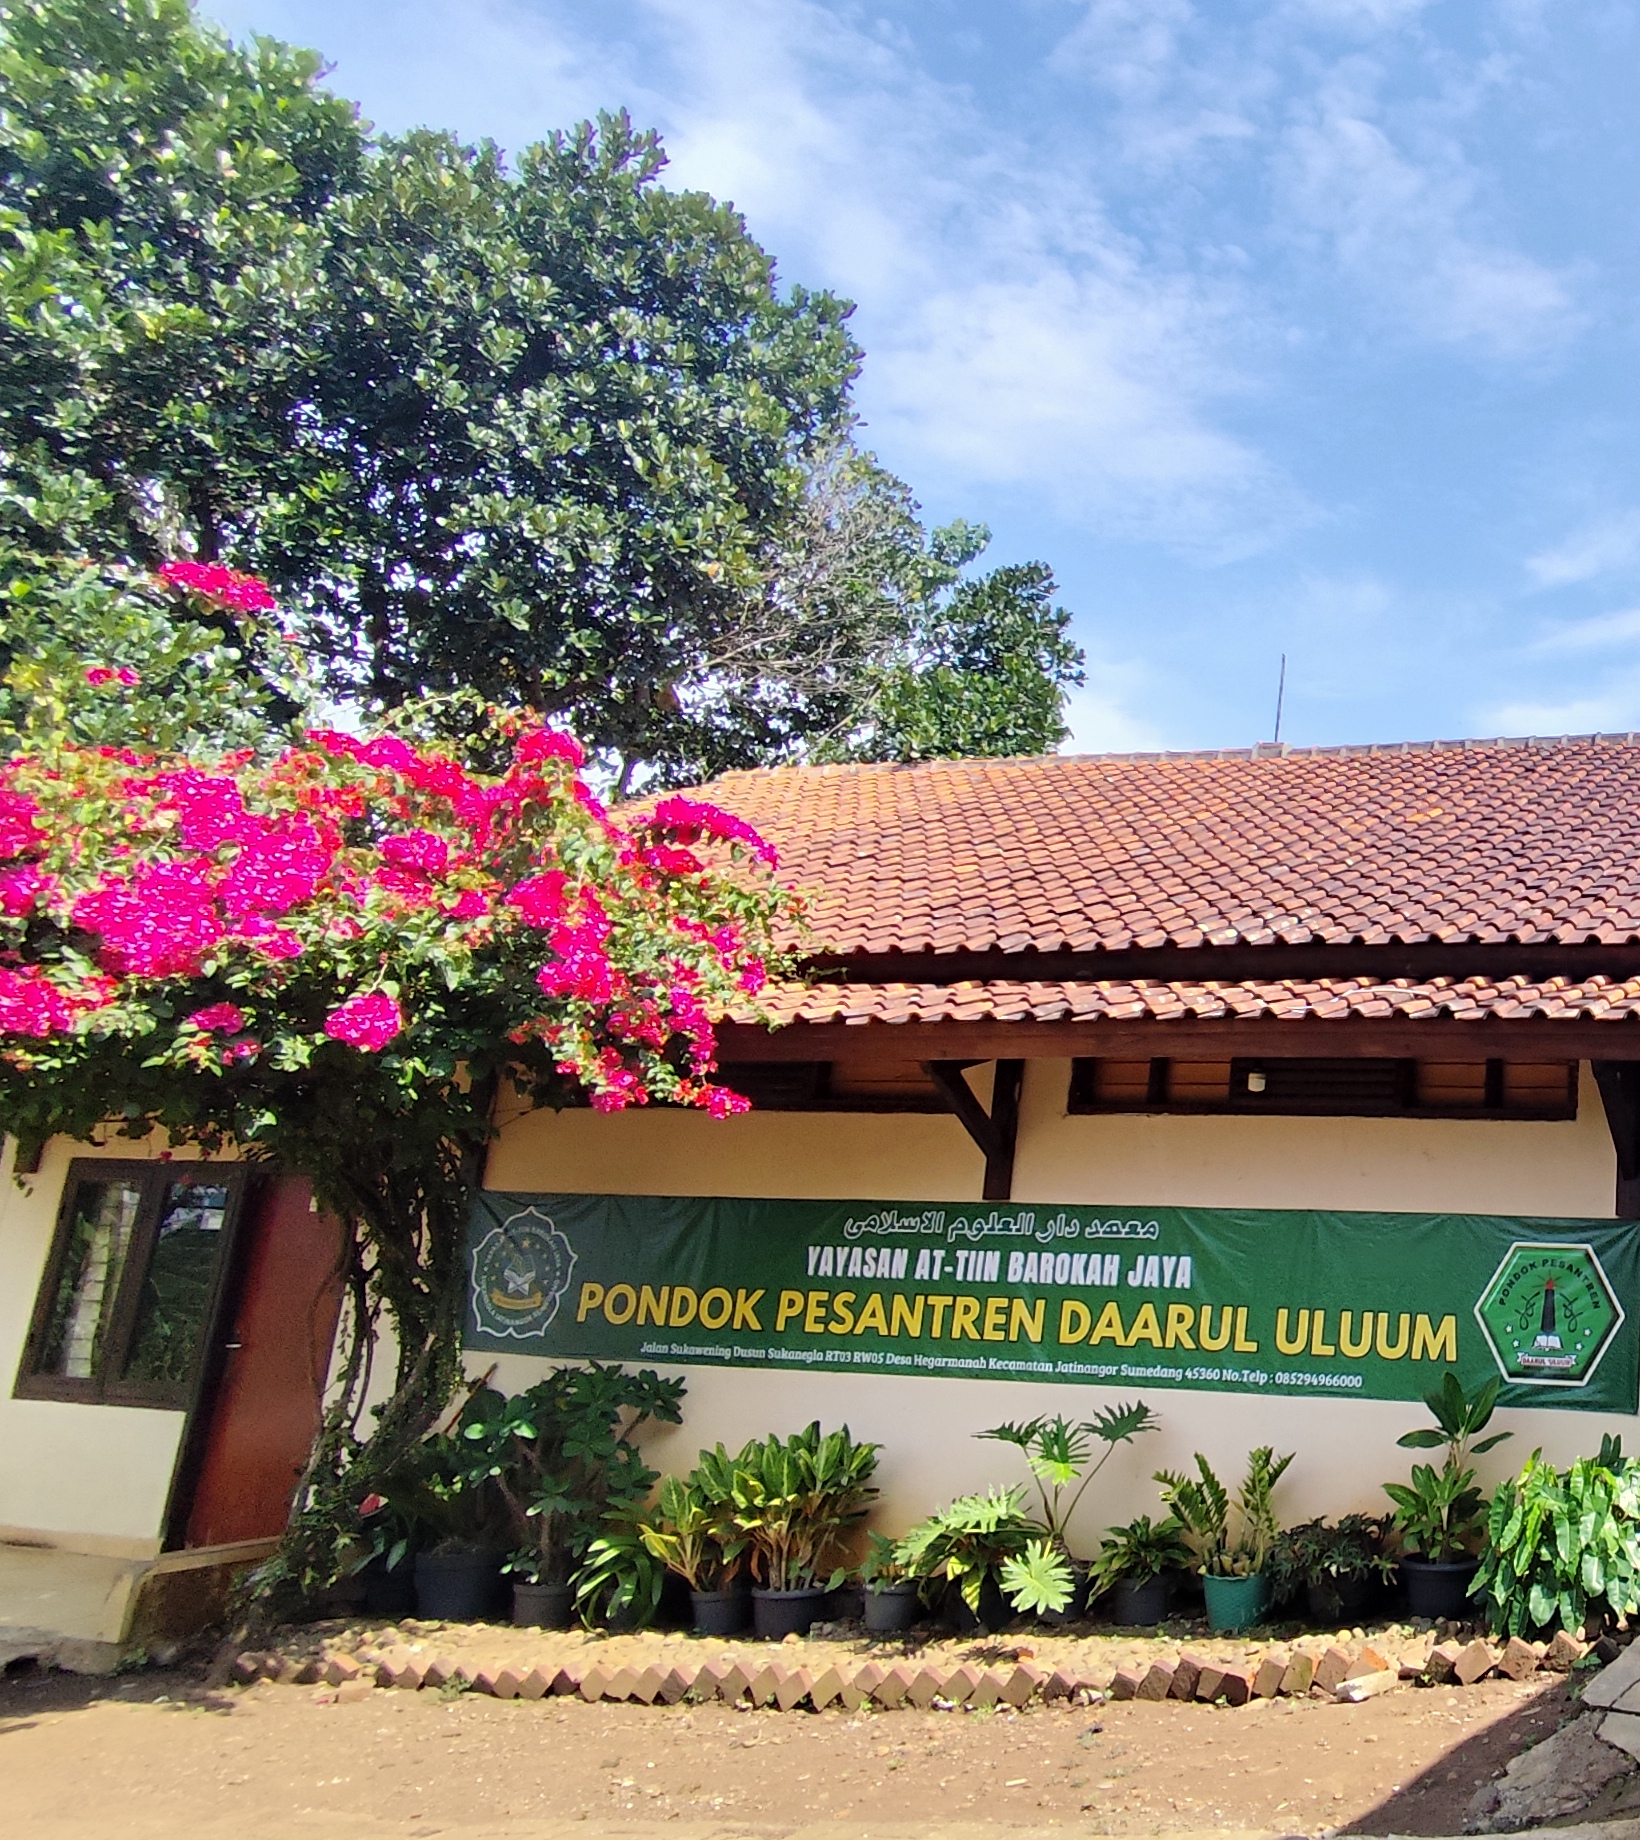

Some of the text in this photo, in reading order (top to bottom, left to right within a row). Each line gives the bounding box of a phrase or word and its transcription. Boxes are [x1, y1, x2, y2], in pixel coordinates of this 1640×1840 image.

[948, 1212, 1033, 1242] العلوم
[1035, 1217, 1080, 1243] دار
[806, 1245, 1193, 1290] YAYASAN AT-TIIN BAROKAH JAYA
[1498, 1258, 1601, 1310] PONDOK PESANTREN
[576, 1281, 765, 1332] PONDOK
[775, 1290, 1046, 1343] PESANTREN
[1058, 1300, 1259, 1353] DAARUL
[1274, 1308, 1458, 1362] ULUUM
[640, 1342, 669, 1354] Jalan
[733, 1346, 765, 1359] Dusun
[825, 1351, 851, 1363] RT03
[853, 1352, 883, 1365] RW05
[885, 1353, 912, 1366] Desa
[913, 1355, 986, 1370] Hegarmanah
[988, 1358, 1053, 1373] Kecamatan
[1054, 1361, 1119, 1378] Jatinangor
[1120, 1364, 1182, 1382] Sumedang
[1185, 1369, 1220, 1381] 45360
[1275, 1374, 1363, 1388] 085294966000
